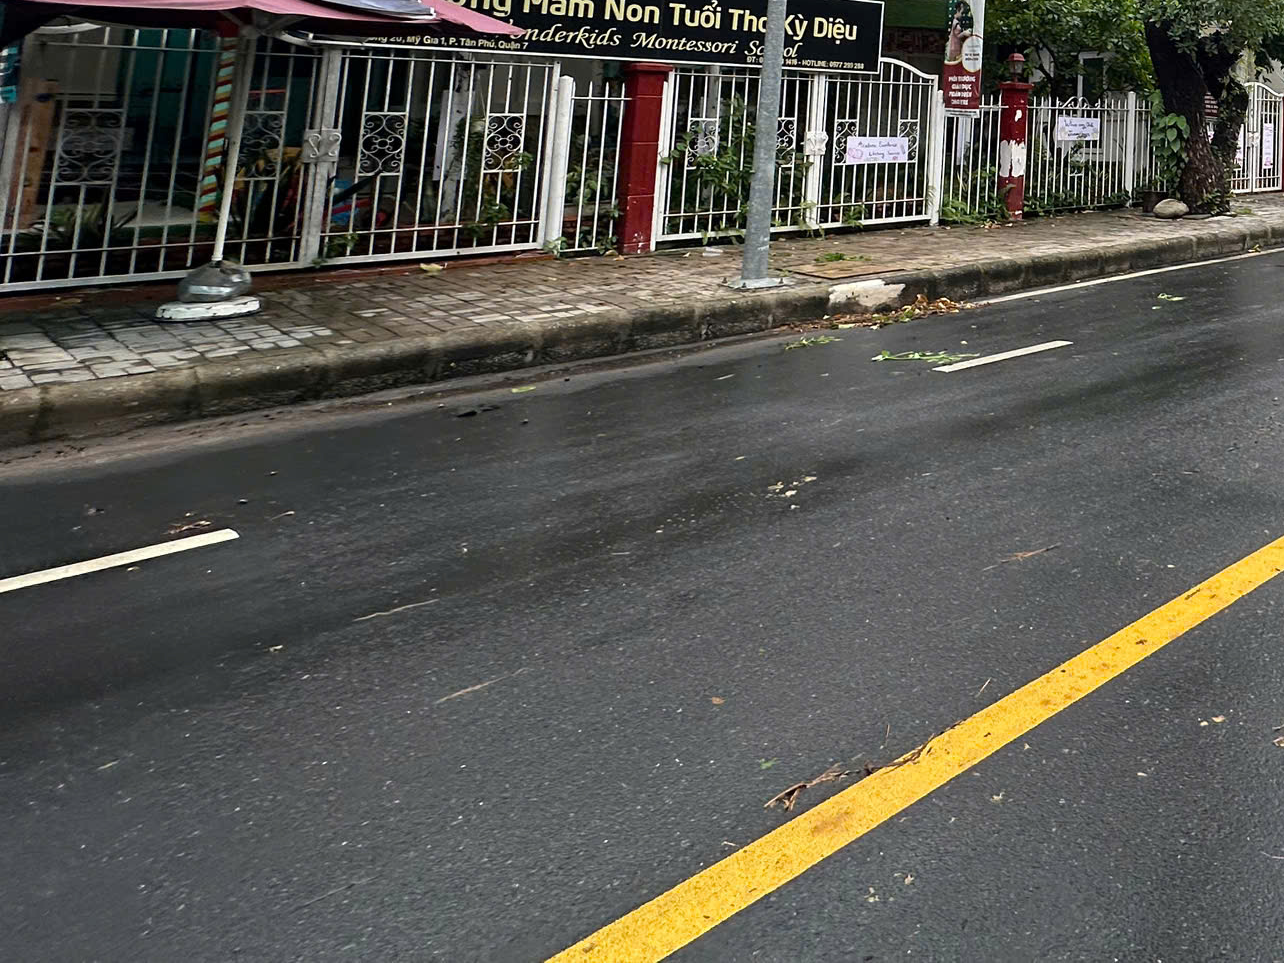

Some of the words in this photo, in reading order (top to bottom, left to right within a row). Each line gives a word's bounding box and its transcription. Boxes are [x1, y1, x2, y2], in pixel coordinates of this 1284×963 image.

[669, 0, 722, 30] Tuổi
[784, 13, 808, 41] Kỳ
[813, 17, 858, 45] Diệu
[407, 35, 420, 46] Mỹ
[424, 35, 438, 45] Gia
[449, 37, 458, 46] P.
[461, 37, 476, 47] Tân
[498, 40, 521, 51] Quận
[523, 42, 529, 50] 7
[630, 31, 739, 54] Montessori
[744, 39, 803, 58] Scol
